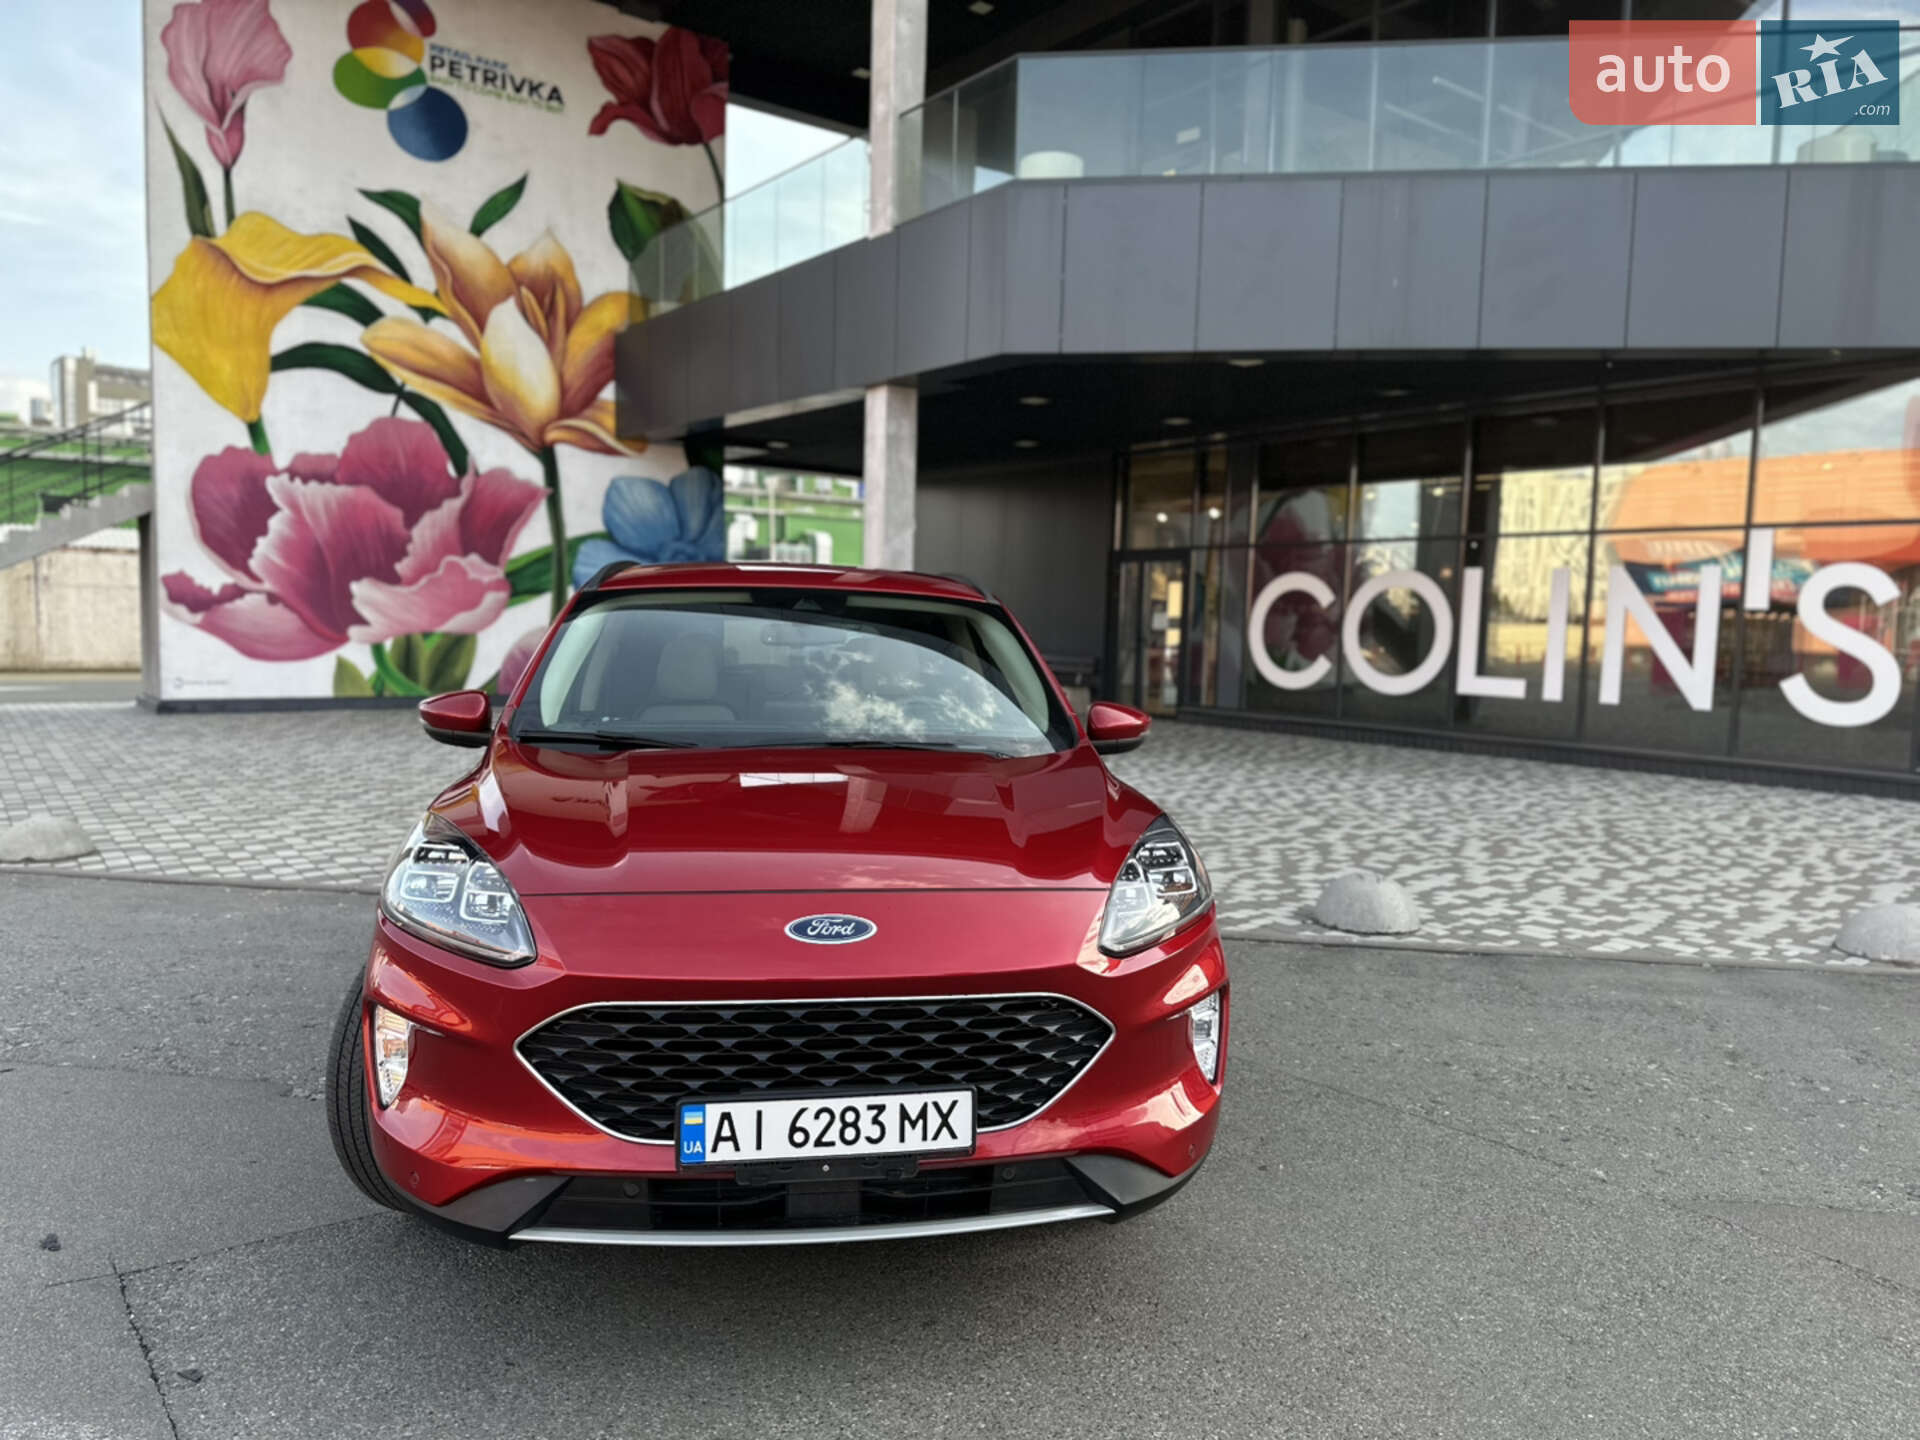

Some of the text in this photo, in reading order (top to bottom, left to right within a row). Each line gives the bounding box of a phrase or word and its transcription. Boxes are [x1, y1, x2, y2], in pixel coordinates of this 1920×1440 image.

[431, 55, 564, 104] PETRIVKA
[1248, 528, 1902, 728] COLIN'S
[807, 918, 856, 936] Ford
[683, 1142, 703, 1154] UA
[711, 1100, 958, 1153] AI 6283 MX
